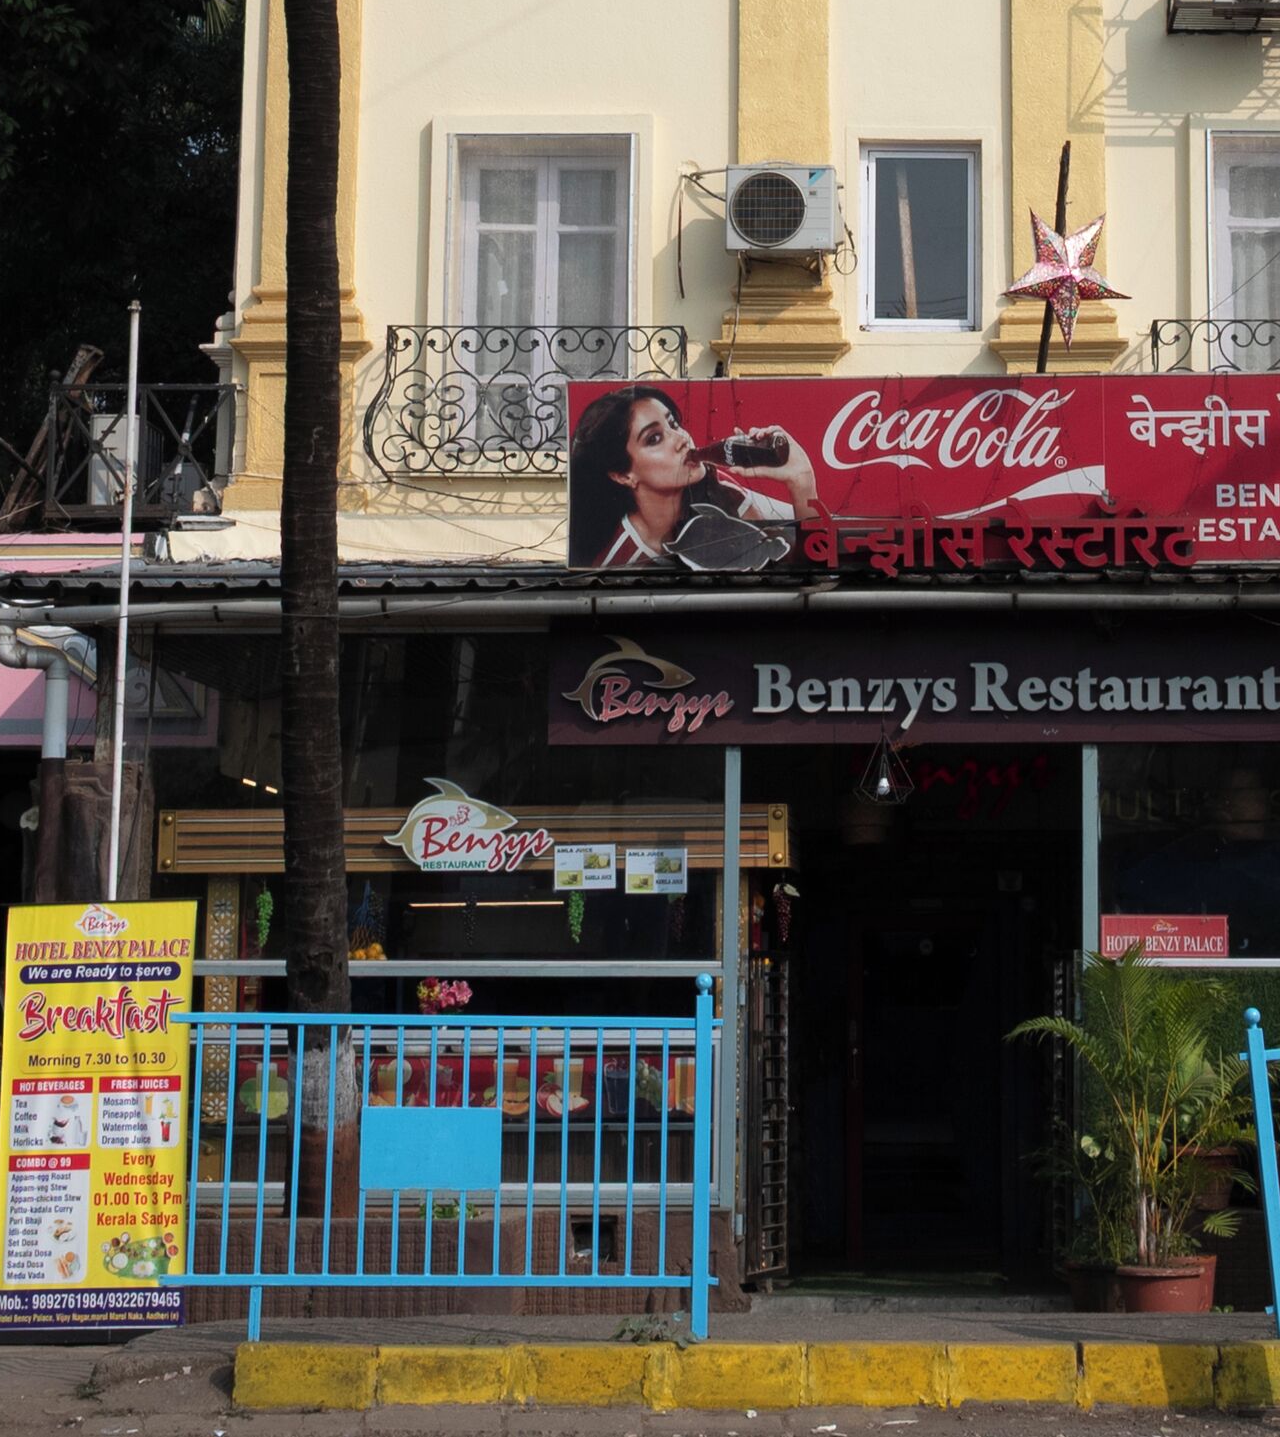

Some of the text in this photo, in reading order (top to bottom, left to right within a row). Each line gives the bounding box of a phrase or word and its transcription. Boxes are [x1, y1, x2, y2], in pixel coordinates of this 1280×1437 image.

[822, 388, 1076, 470] Coca-Cola
[1126, 393, 1270, 455] बेन्झीस
[598, 676, 734, 732] Benzys
[752, 663, 957, 730] Benzys
[421, 817, 549, 870] Benzys
[423, 860, 487, 869] RESTAURANT
[88, 916, 127, 934] Benzys
[15, 938, 190, 961] HOTEL BENZY PALACE
[1146, 936, 1181, 952] BENZY
[1184, 936, 1223, 952] PALACE
[28, 965, 172, 980] We are Ready to serve
[18, 986, 185, 1041] Breakfast
[28, 1051, 165, 1068] Morning 7.30 to 10.30
[20, 1080, 85, 1092] HOT BEVERAGES
[111, 1078, 169, 1089] FRESH JUICES
[15, 1099, 28, 1109] Tea
[103, 1096, 138, 1106] Mosambi
[14, 1112, 37, 1121] Coffee
[102, 1109, 141, 1120] Pineapple
[102, 1122, 148, 1132] Watermelon
[123, 1152, 155, 1168] Every
[104, 1172, 174, 1187] Wednesday
[94, 1191, 182, 1206] 01.00 To 3 Pm
[97, 1212, 178, 1227] Kerala Sadya
